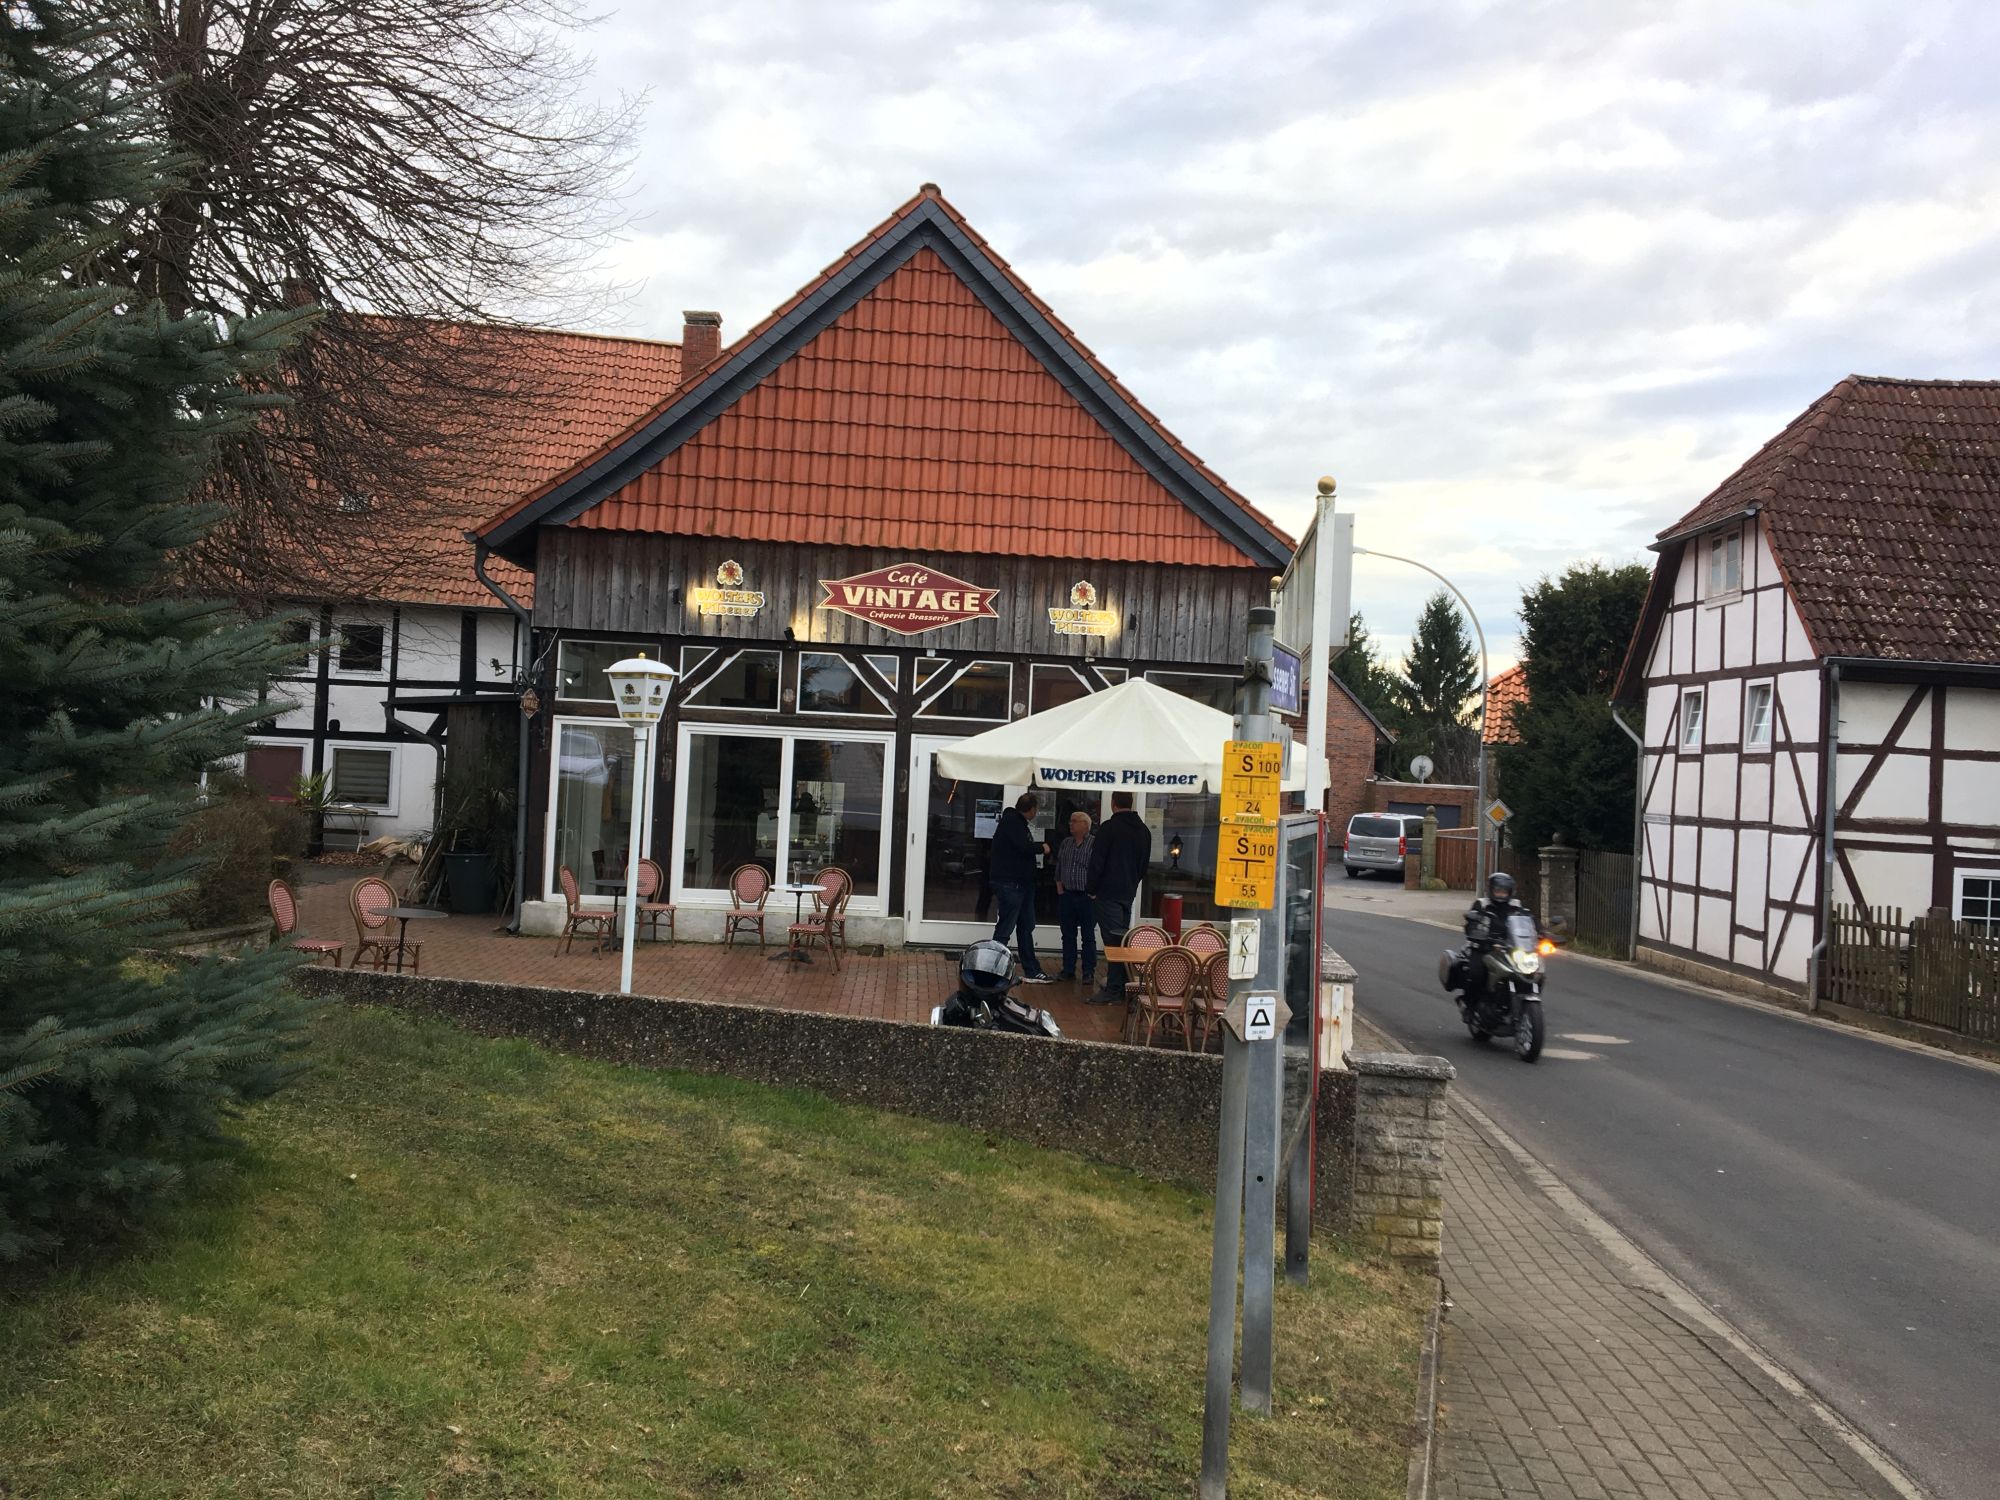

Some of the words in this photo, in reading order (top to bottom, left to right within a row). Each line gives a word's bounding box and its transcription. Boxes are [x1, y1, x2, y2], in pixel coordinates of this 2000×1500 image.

[888, 570, 928, 586] Café
[696, 588, 763, 606] WOLTERS
[842, 586, 981, 612] VINTAGE
[869, 610, 905, 620] Crêperie
[908, 613, 949, 622] Brasserie
[1055, 622, 1107, 635] Pilsen
[1233, 742, 1264, 750] avacon
[1242, 755, 1253, 773] S
[1259, 761, 1280, 773] 100
[1040, 768, 1116, 784] WOLTERS
[1121, 769, 1198, 785] Pilsener
[1237, 837, 1248, 854] S
[1252, 844, 1274, 856] 100
[1241, 935, 1249, 953] K
[1241, 955, 1247, 973] 7
